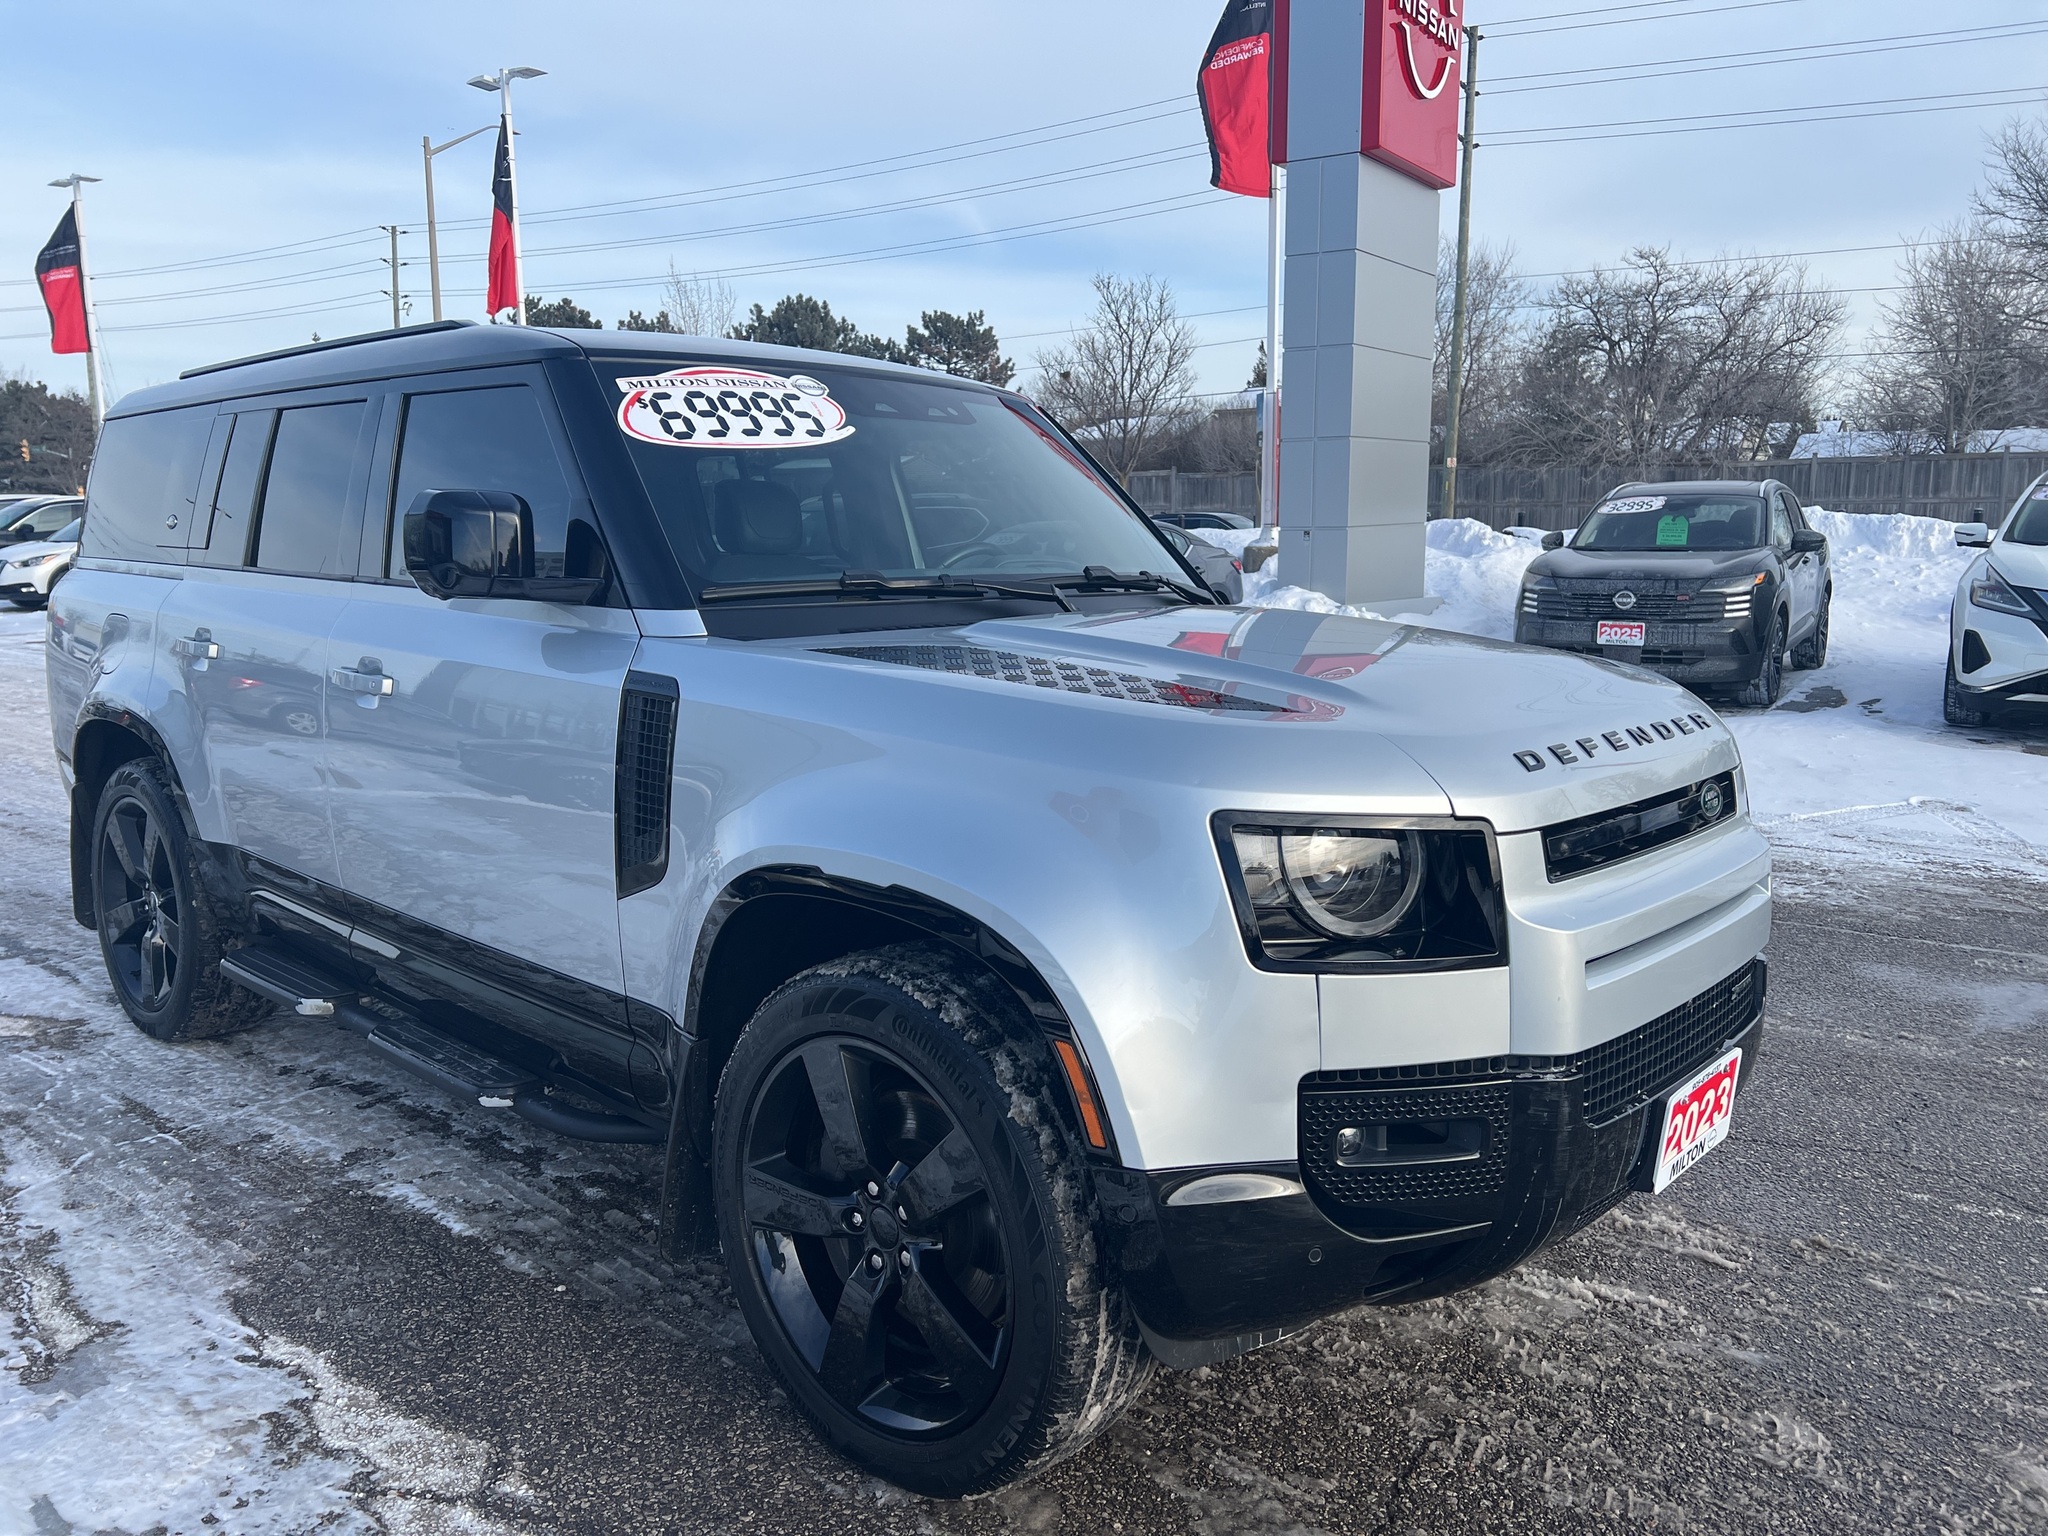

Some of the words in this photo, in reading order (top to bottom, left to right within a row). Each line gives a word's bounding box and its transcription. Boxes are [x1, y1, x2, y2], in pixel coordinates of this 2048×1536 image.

[627, 378, 709, 389] MILTON
[715, 378, 787, 389] NISSAN
[1600, 626, 1641, 641] 2025
[1513, 712, 1712, 773] DEFENDER
[891, 1014, 977, 1100] Continental
[1663, 1076, 1732, 1164] 2023
[1669, 1138, 1706, 1181] MILTON
